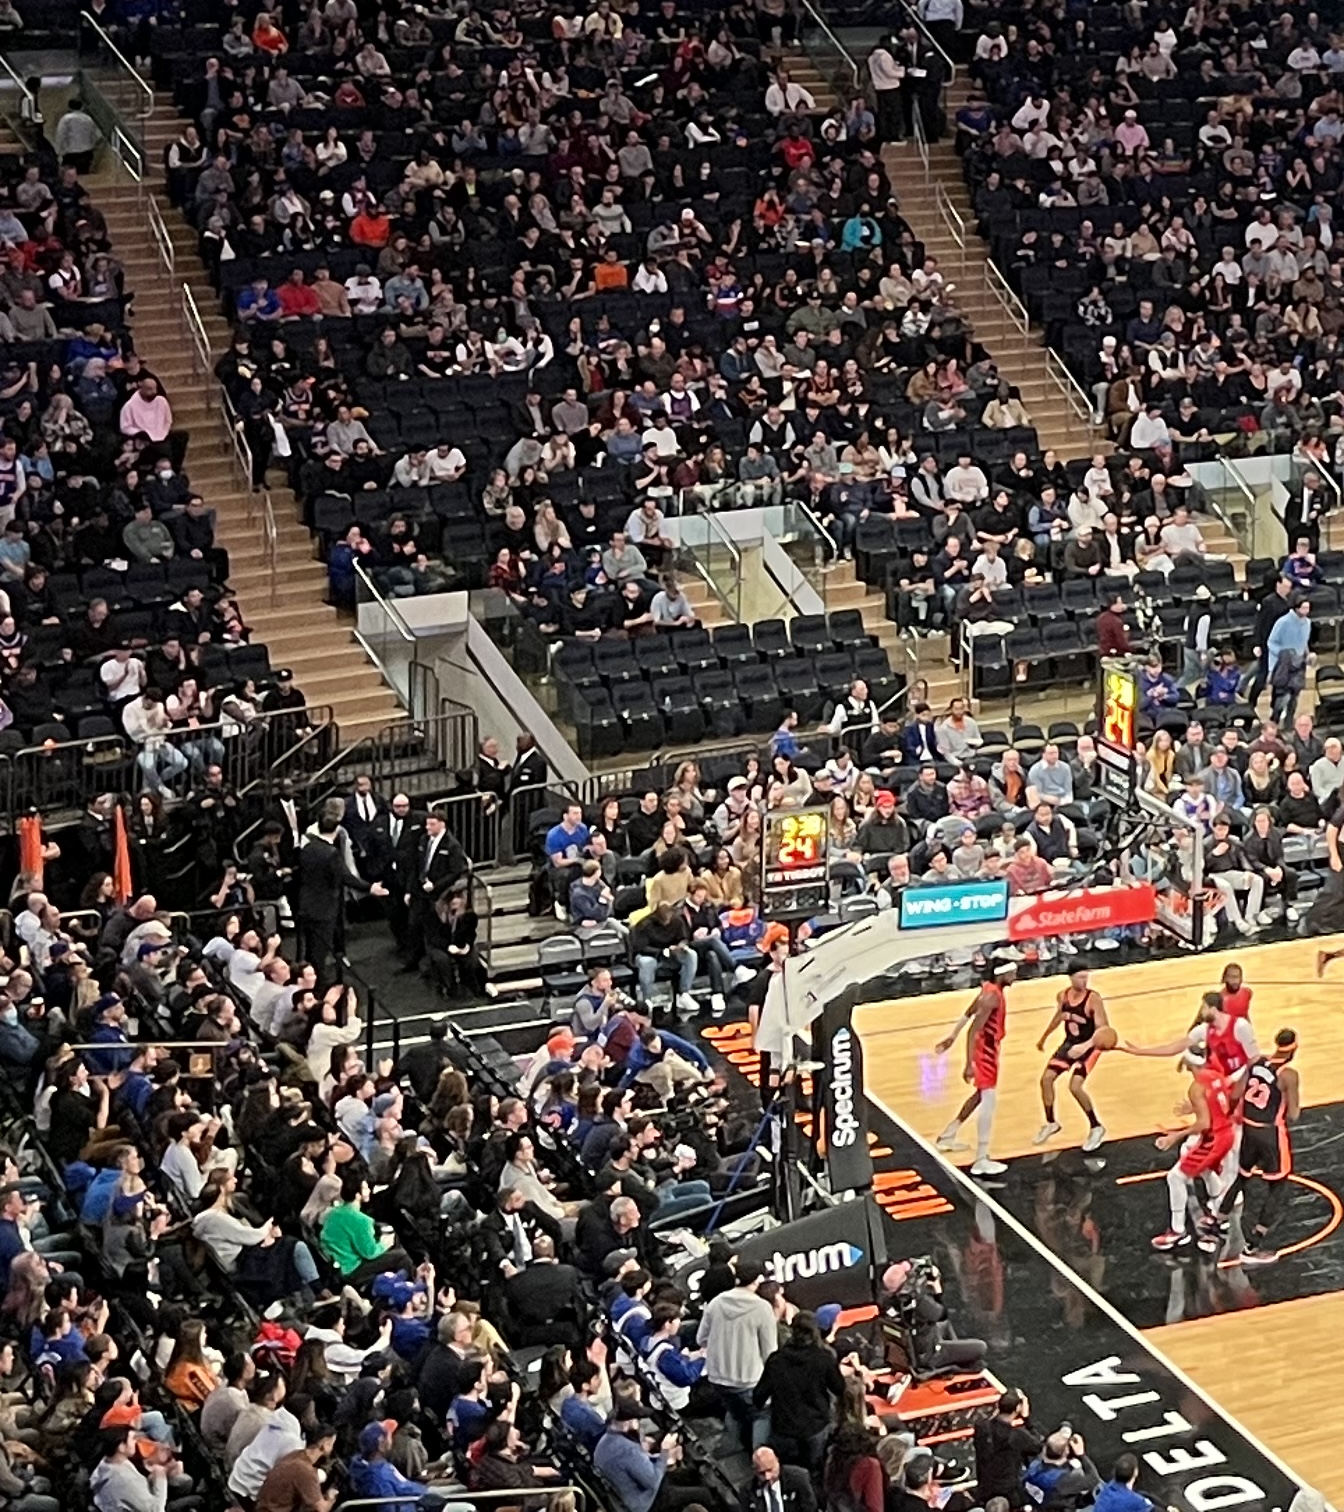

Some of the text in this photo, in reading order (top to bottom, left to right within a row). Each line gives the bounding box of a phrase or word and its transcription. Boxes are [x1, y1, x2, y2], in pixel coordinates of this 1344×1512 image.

[778, 836, 815, 863] 24
[960, 893, 1005, 910] STOP
[830, 1036, 860, 1148] Spectrum
[1060, 1355, 1267, 1512] DELTA
